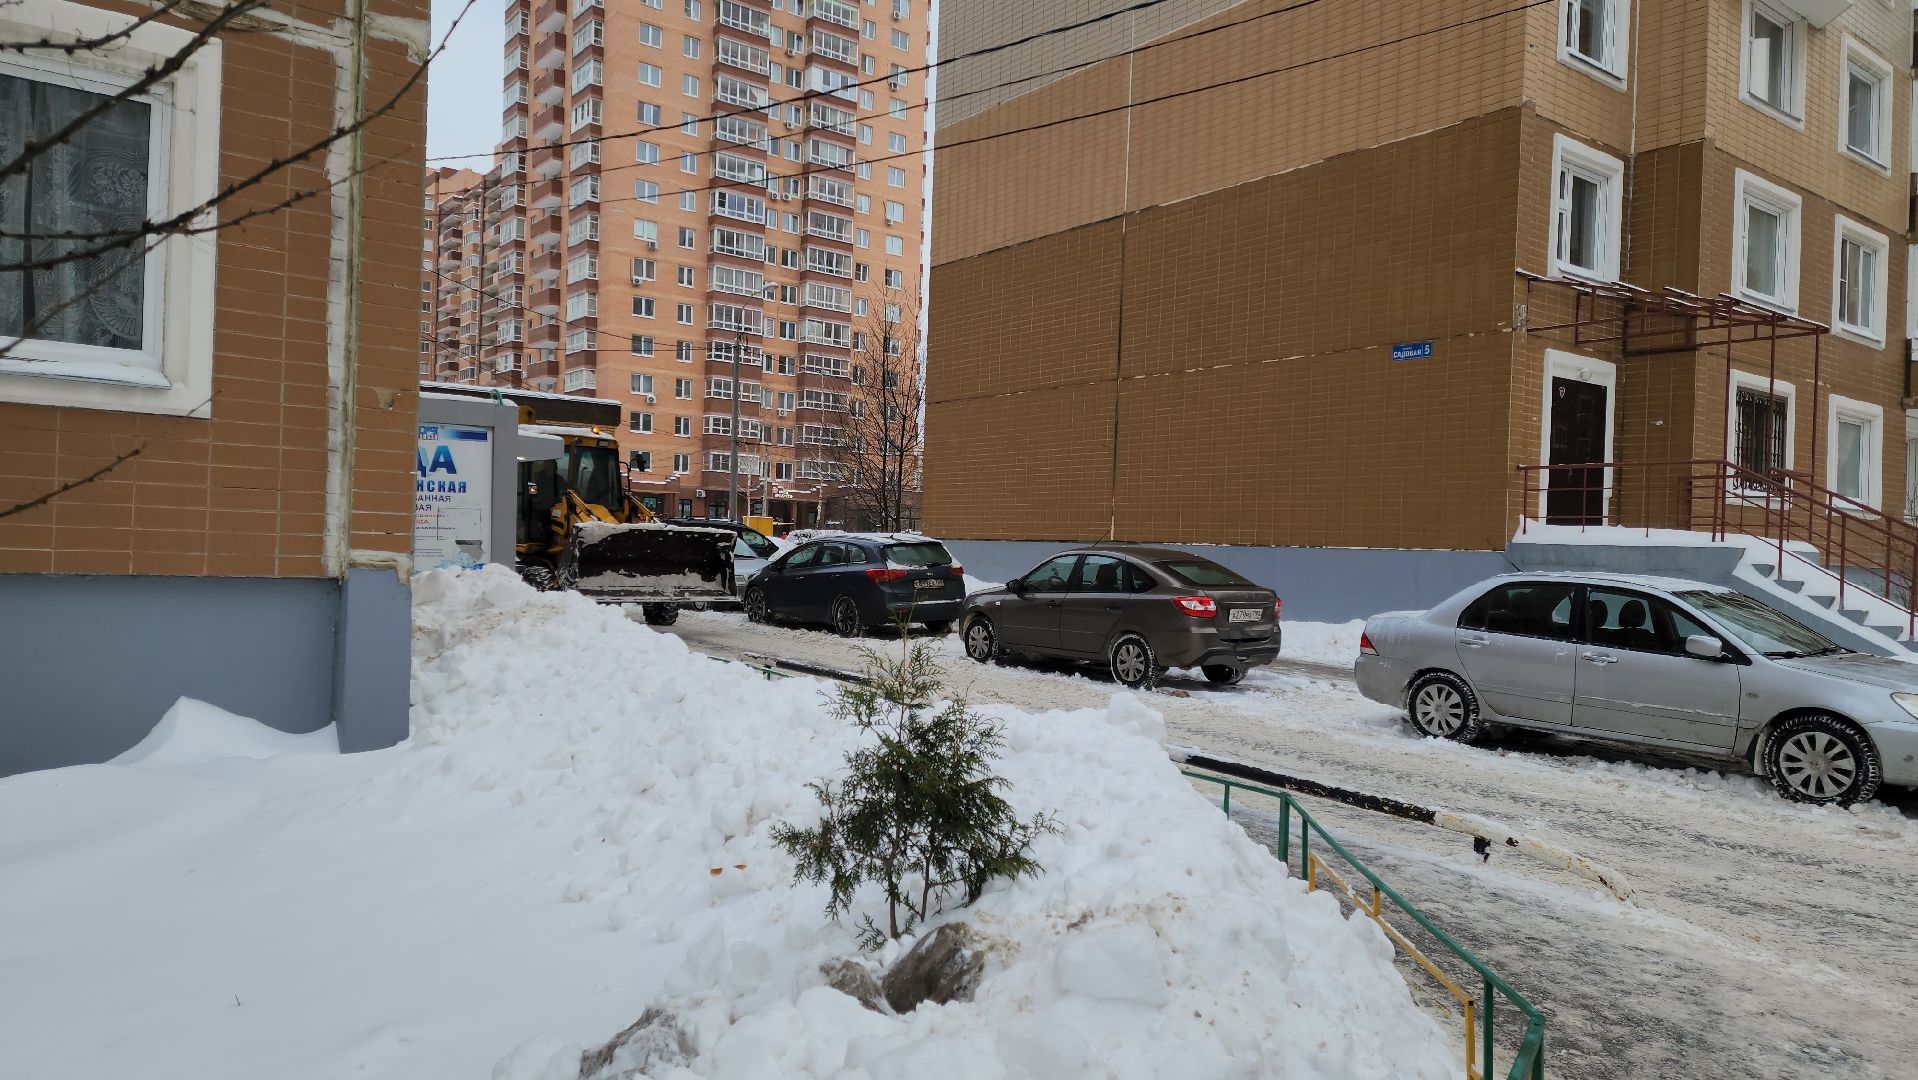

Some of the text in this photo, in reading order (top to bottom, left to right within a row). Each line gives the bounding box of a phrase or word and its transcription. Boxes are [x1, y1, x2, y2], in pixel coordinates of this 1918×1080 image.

[1393, 344, 1430, 359] САДОВАЯ 5
[416, 494, 451, 502] АННАЯ
